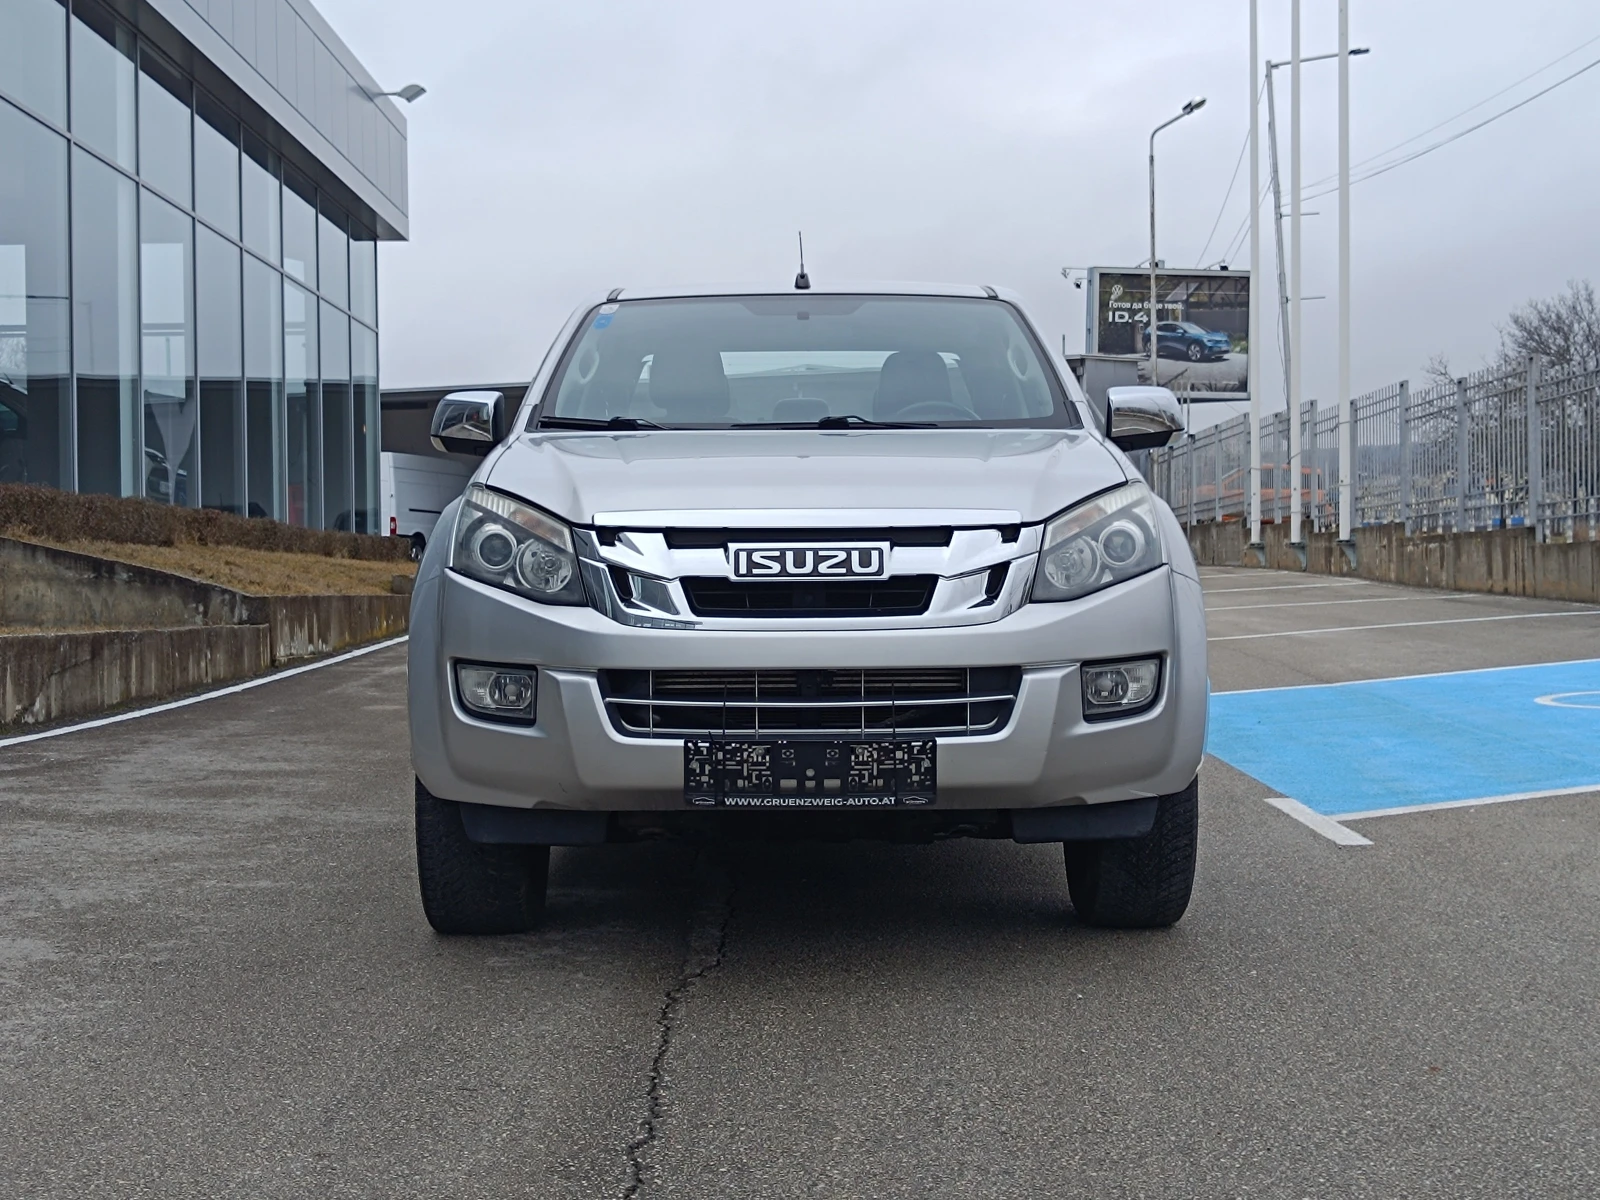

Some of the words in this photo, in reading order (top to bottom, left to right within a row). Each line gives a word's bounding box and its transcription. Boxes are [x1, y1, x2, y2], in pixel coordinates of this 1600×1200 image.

[1109, 301, 1131, 309] Готов
[1132, 302, 1142, 310] да
[1108, 311, 1149, 323] ID.4
[738, 550, 880, 575] ISUZU
[724, 797, 896, 806] WWW.GRUENZWEIG-AUTO.AT
